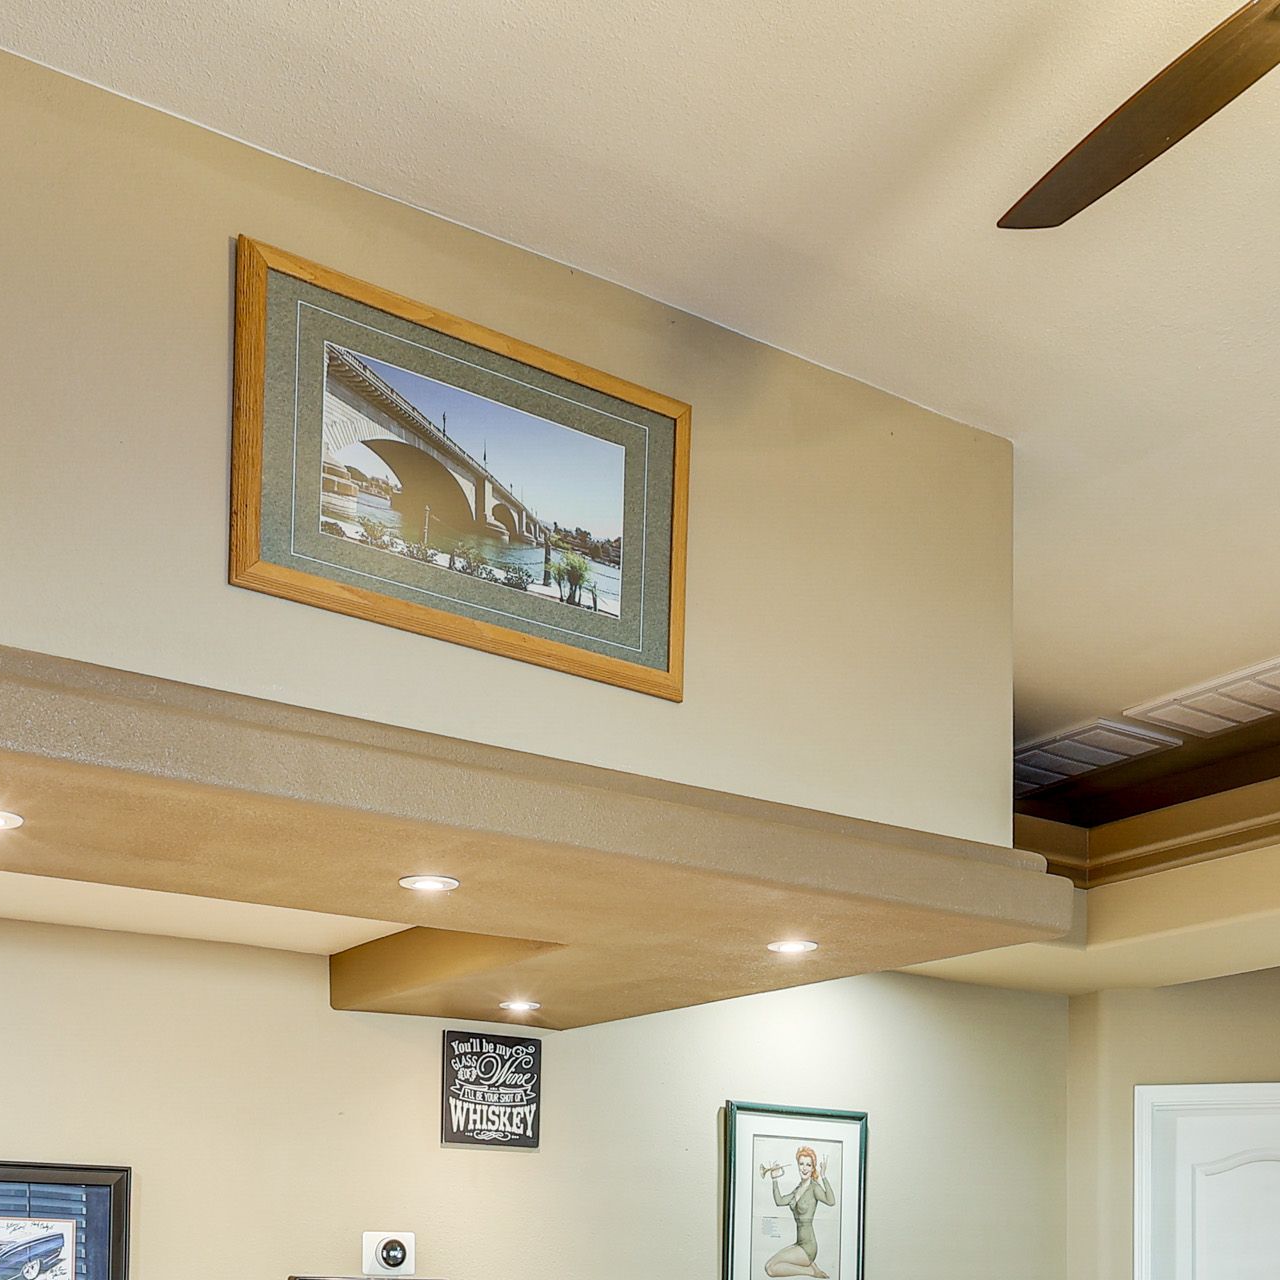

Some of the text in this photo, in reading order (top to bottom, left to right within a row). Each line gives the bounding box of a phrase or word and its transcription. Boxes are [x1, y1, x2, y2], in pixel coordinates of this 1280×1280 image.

[451, 1037, 512, 1059] You'll be my
[451, 1054, 478, 1071] GLASS
[477, 1053, 537, 1087] Wine
[464, 1088, 522, 1102] I'LL BE YOUR SHOT OF
[449, 1096, 537, 1137] WHISKEY
